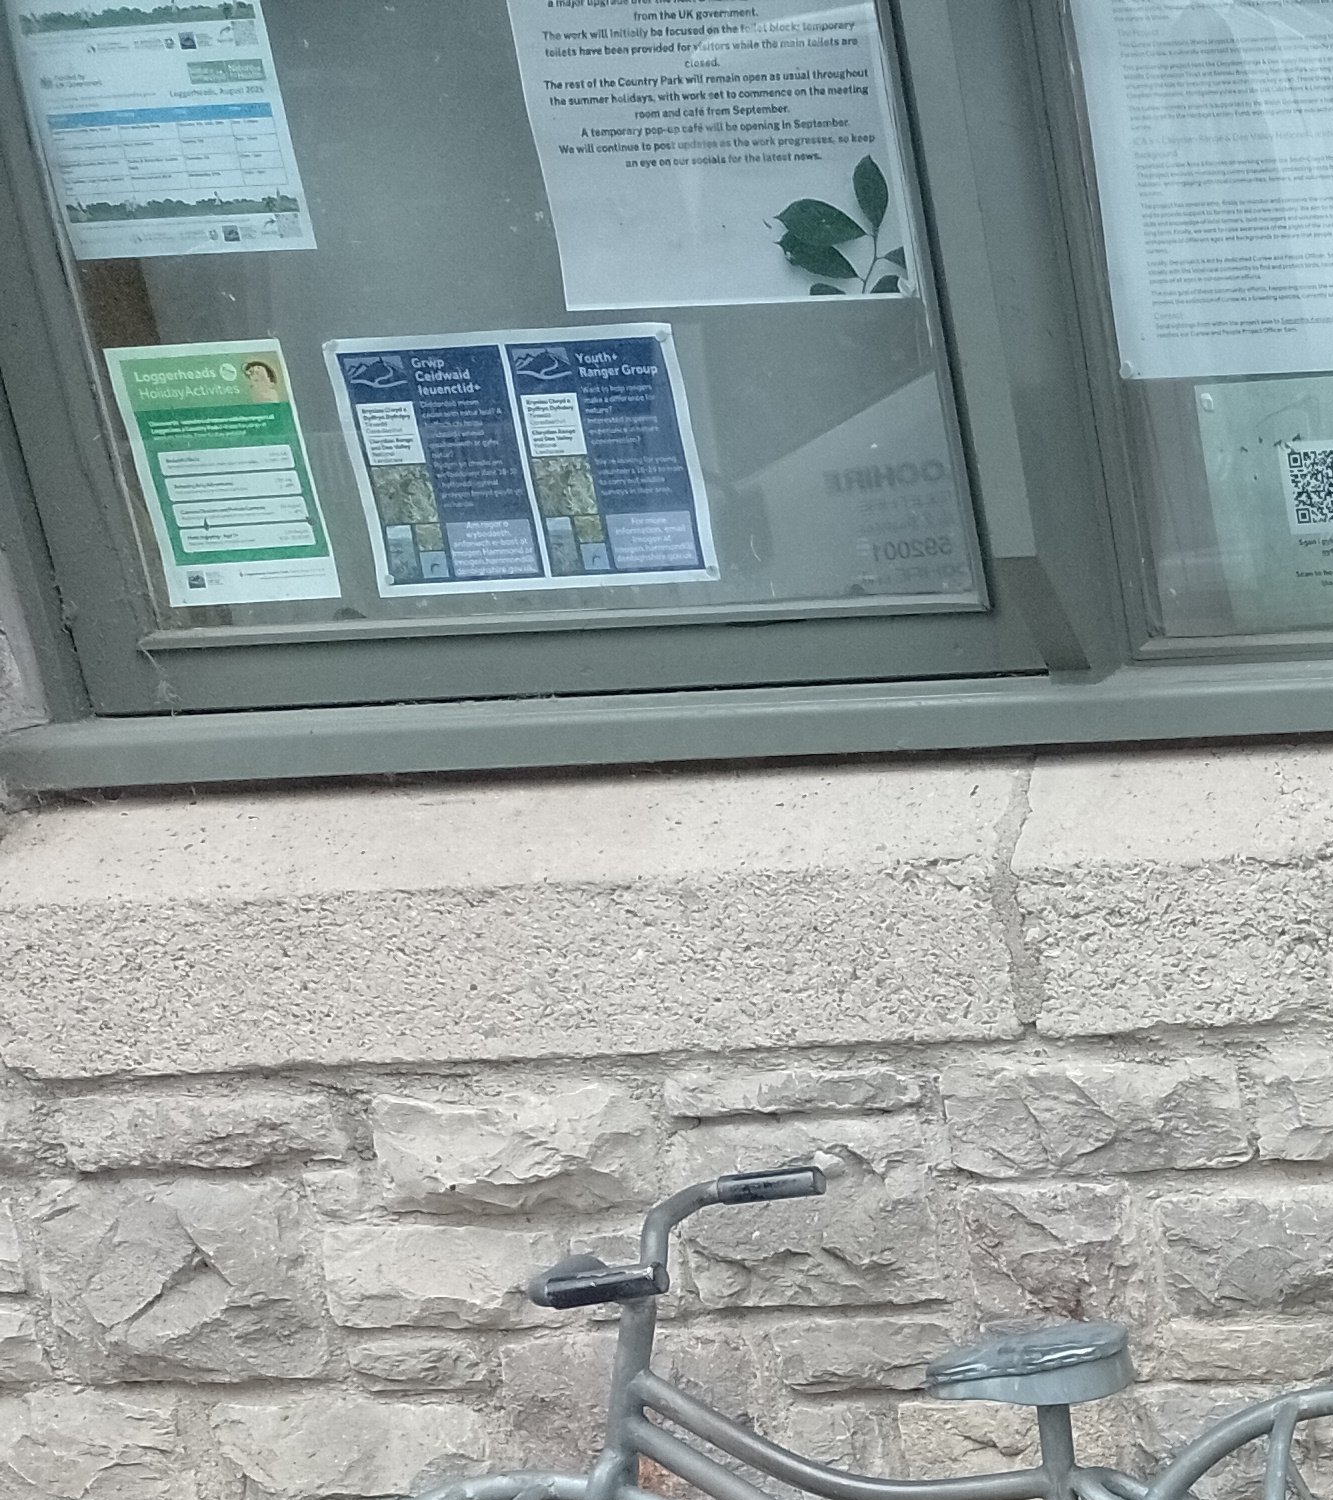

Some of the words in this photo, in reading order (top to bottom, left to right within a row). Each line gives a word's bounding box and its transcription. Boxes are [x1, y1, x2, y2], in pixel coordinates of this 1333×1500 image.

[542, 30, 562, 40] The
[564, 30, 588, 40] work
[590, 28, 608, 39] will
[665, 25, 704, 36] focused
[722, 23, 738, 34] the
[545, 47, 577, 58] toilets
[579, 46, 602, 56] have
[604, 45, 629, 56] been
[631, 43, 674, 56] provided
[677, 42, 692, 52] for
[732, 38, 760, 50] while
[762, 38, 778, 48] the
[780, 38, 805, 48] main
[808, 37, 840, 48] toilets
[842, 38, 858, 46] are
[544, 80, 562, 90] The
[565, 80, 585, 90] rest
[600, 77, 616, 88] the
[618, 76, 658, 88] Country
[660, 75, 684, 86] Park
[686, 74, 704, 85] will
[706, 72, 740, 83] remain
[742, 74, 768, 84] open
[783, 70, 810, 80] usual
[812, 68, 868, 80] throughout
[550, 96, 566, 106] the
[568, 97, 610, 106] summer
[658, 92, 680, 102] with
[682, 91, 706, 101] work
[708, 90, 724, 99] set
[738, 88, 792, 98] commence
[810, 85, 826, 96] the
[828, 86, 869, 96] meeting
[635, 110, 660, 120] room
[662, 108, 681, 118] and
[706, 106, 730, 116] from
[591, 126, 642, 138] temporary
[706, 121, 724, 131] will
[740, 121, 780, 132] opening
[576, 143, 594, 154] will
[596, 142, 639, 154] continue
[654, 142, 676, 152] post
[734, 136, 750, 147] the
[752, 135, 776, 146] work
[851, 134, 876, 144] keep
[134, 367, 217, 385] Loggerheads
[415, 368, 470, 382] Ceidwaid
[579, 366, 620, 379] Ranger
[622, 364, 658, 377] Group
